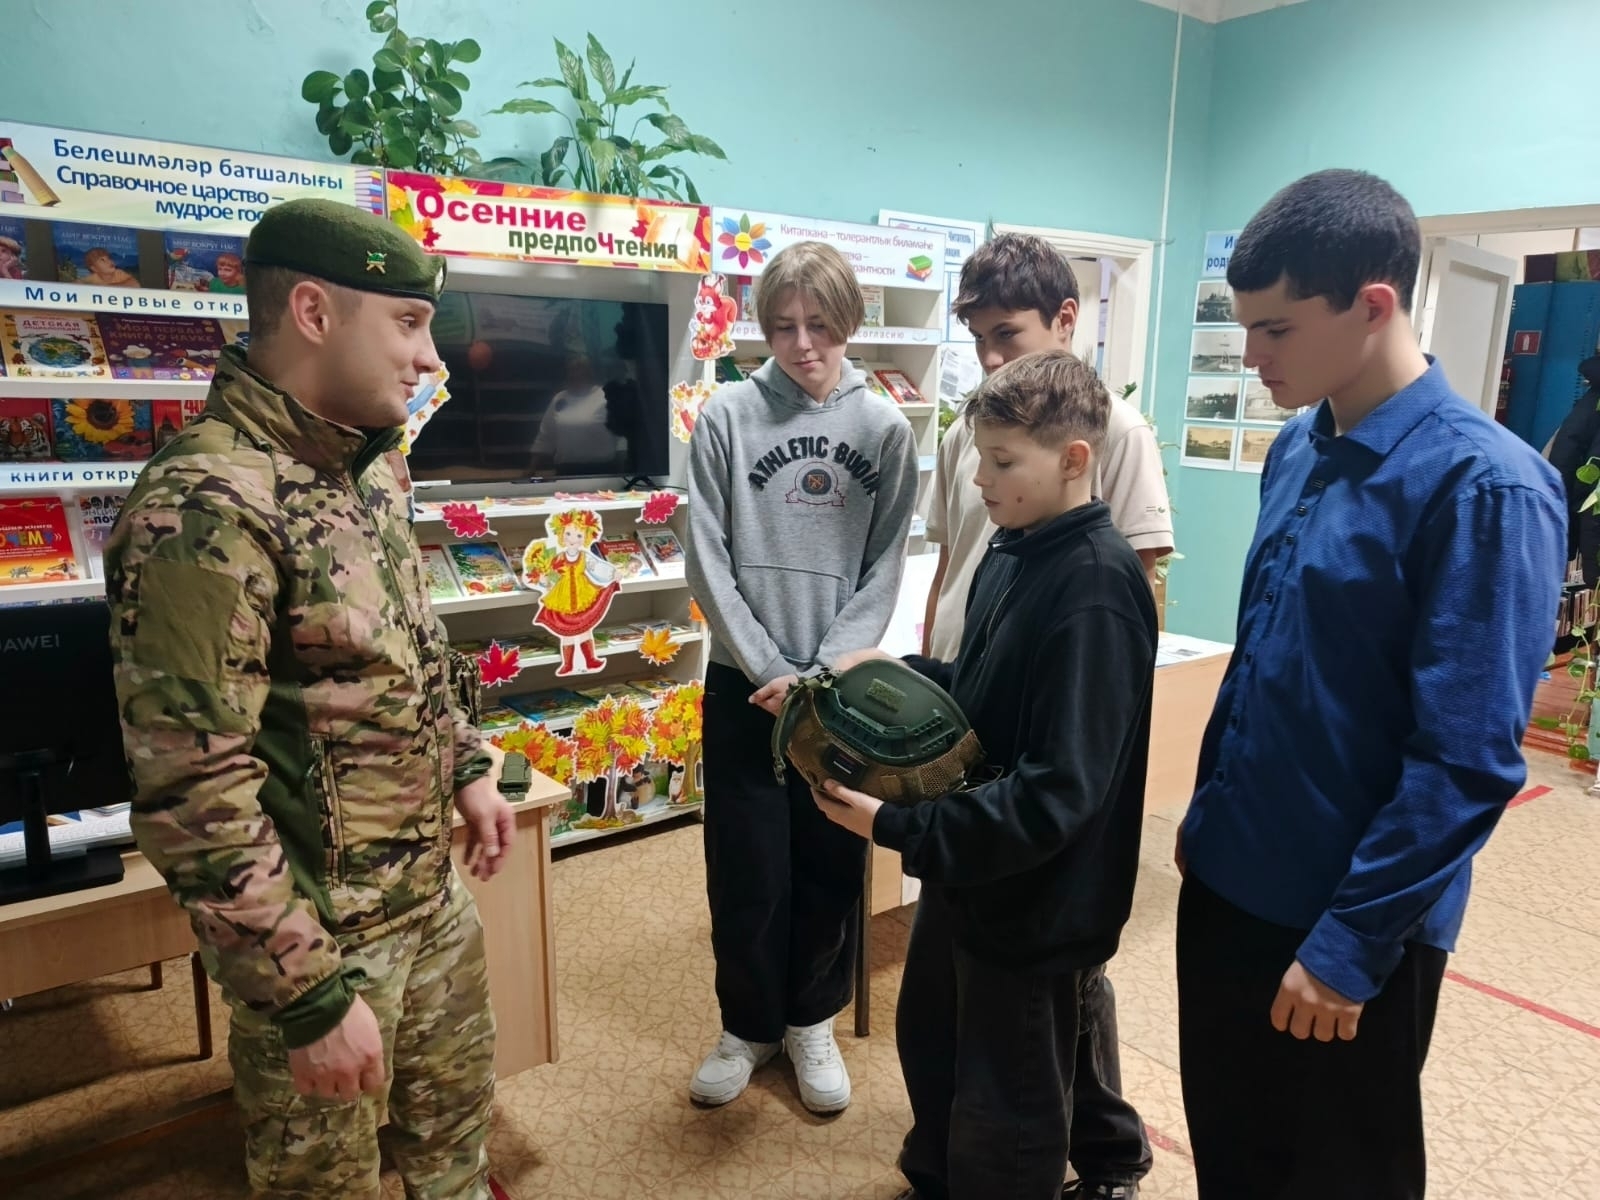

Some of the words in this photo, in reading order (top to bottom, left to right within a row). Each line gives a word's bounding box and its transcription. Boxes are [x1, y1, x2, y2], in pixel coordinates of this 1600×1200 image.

[54, 138, 213, 178] Белешмәләр
[219, 158, 344, 190] батшалығы
[56, 164, 188, 196] Справочное
[192, 183, 270, 205] царство
[156, 200, 234, 223] мудрое
[416, 188, 587, 232] Осенние
[508, 229, 679, 260] предпоЧтения
[25, 286, 78, 304] Мои
[92, 293, 181, 310] первые
[193, 299, 243, 315] откр
[11, 471, 74, 483] книги
[748, 436, 829, 491] ATHLETIC
[0, 633, 61, 653] AWEI
